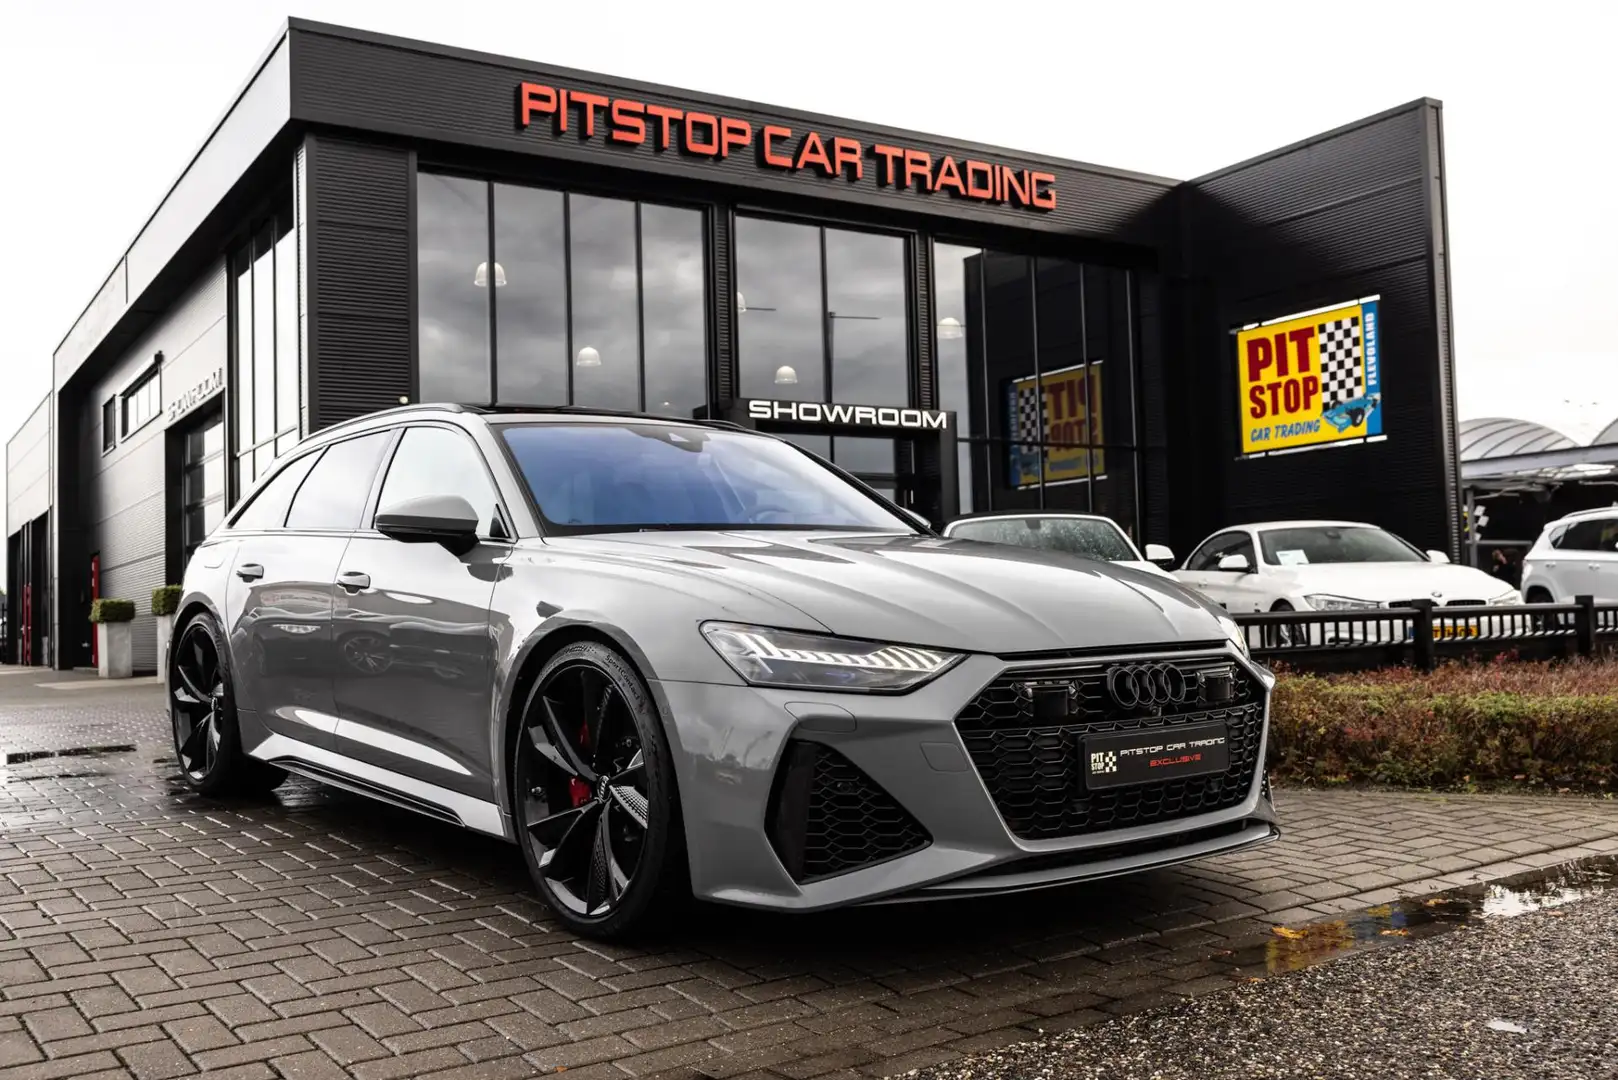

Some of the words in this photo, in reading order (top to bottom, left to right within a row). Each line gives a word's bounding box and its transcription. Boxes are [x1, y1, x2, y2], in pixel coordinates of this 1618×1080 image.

[521, 82, 752, 158] PITSTOP
[763, 126, 863, 180] CAR
[874, 143, 1057, 211] TRADING
[1246, 326, 1315, 382] PIT
[1364, 312, 1377, 386] FLEVOLAND
[1249, 375, 1319, 419] STOP
[748, 399, 948, 430] SHOWROOM
[1250, 427, 1271, 442] CAR
[1274, 419, 1321, 439] TRADING
[1091, 752, 1104, 763] PIT
[1120, 745, 1163, 757] PITSTOP
[1166, 742, 1186, 751] CAR
[1149, 753, 1202, 767] EXCLUSIVE
[1091, 762, 1105, 771] STOP
